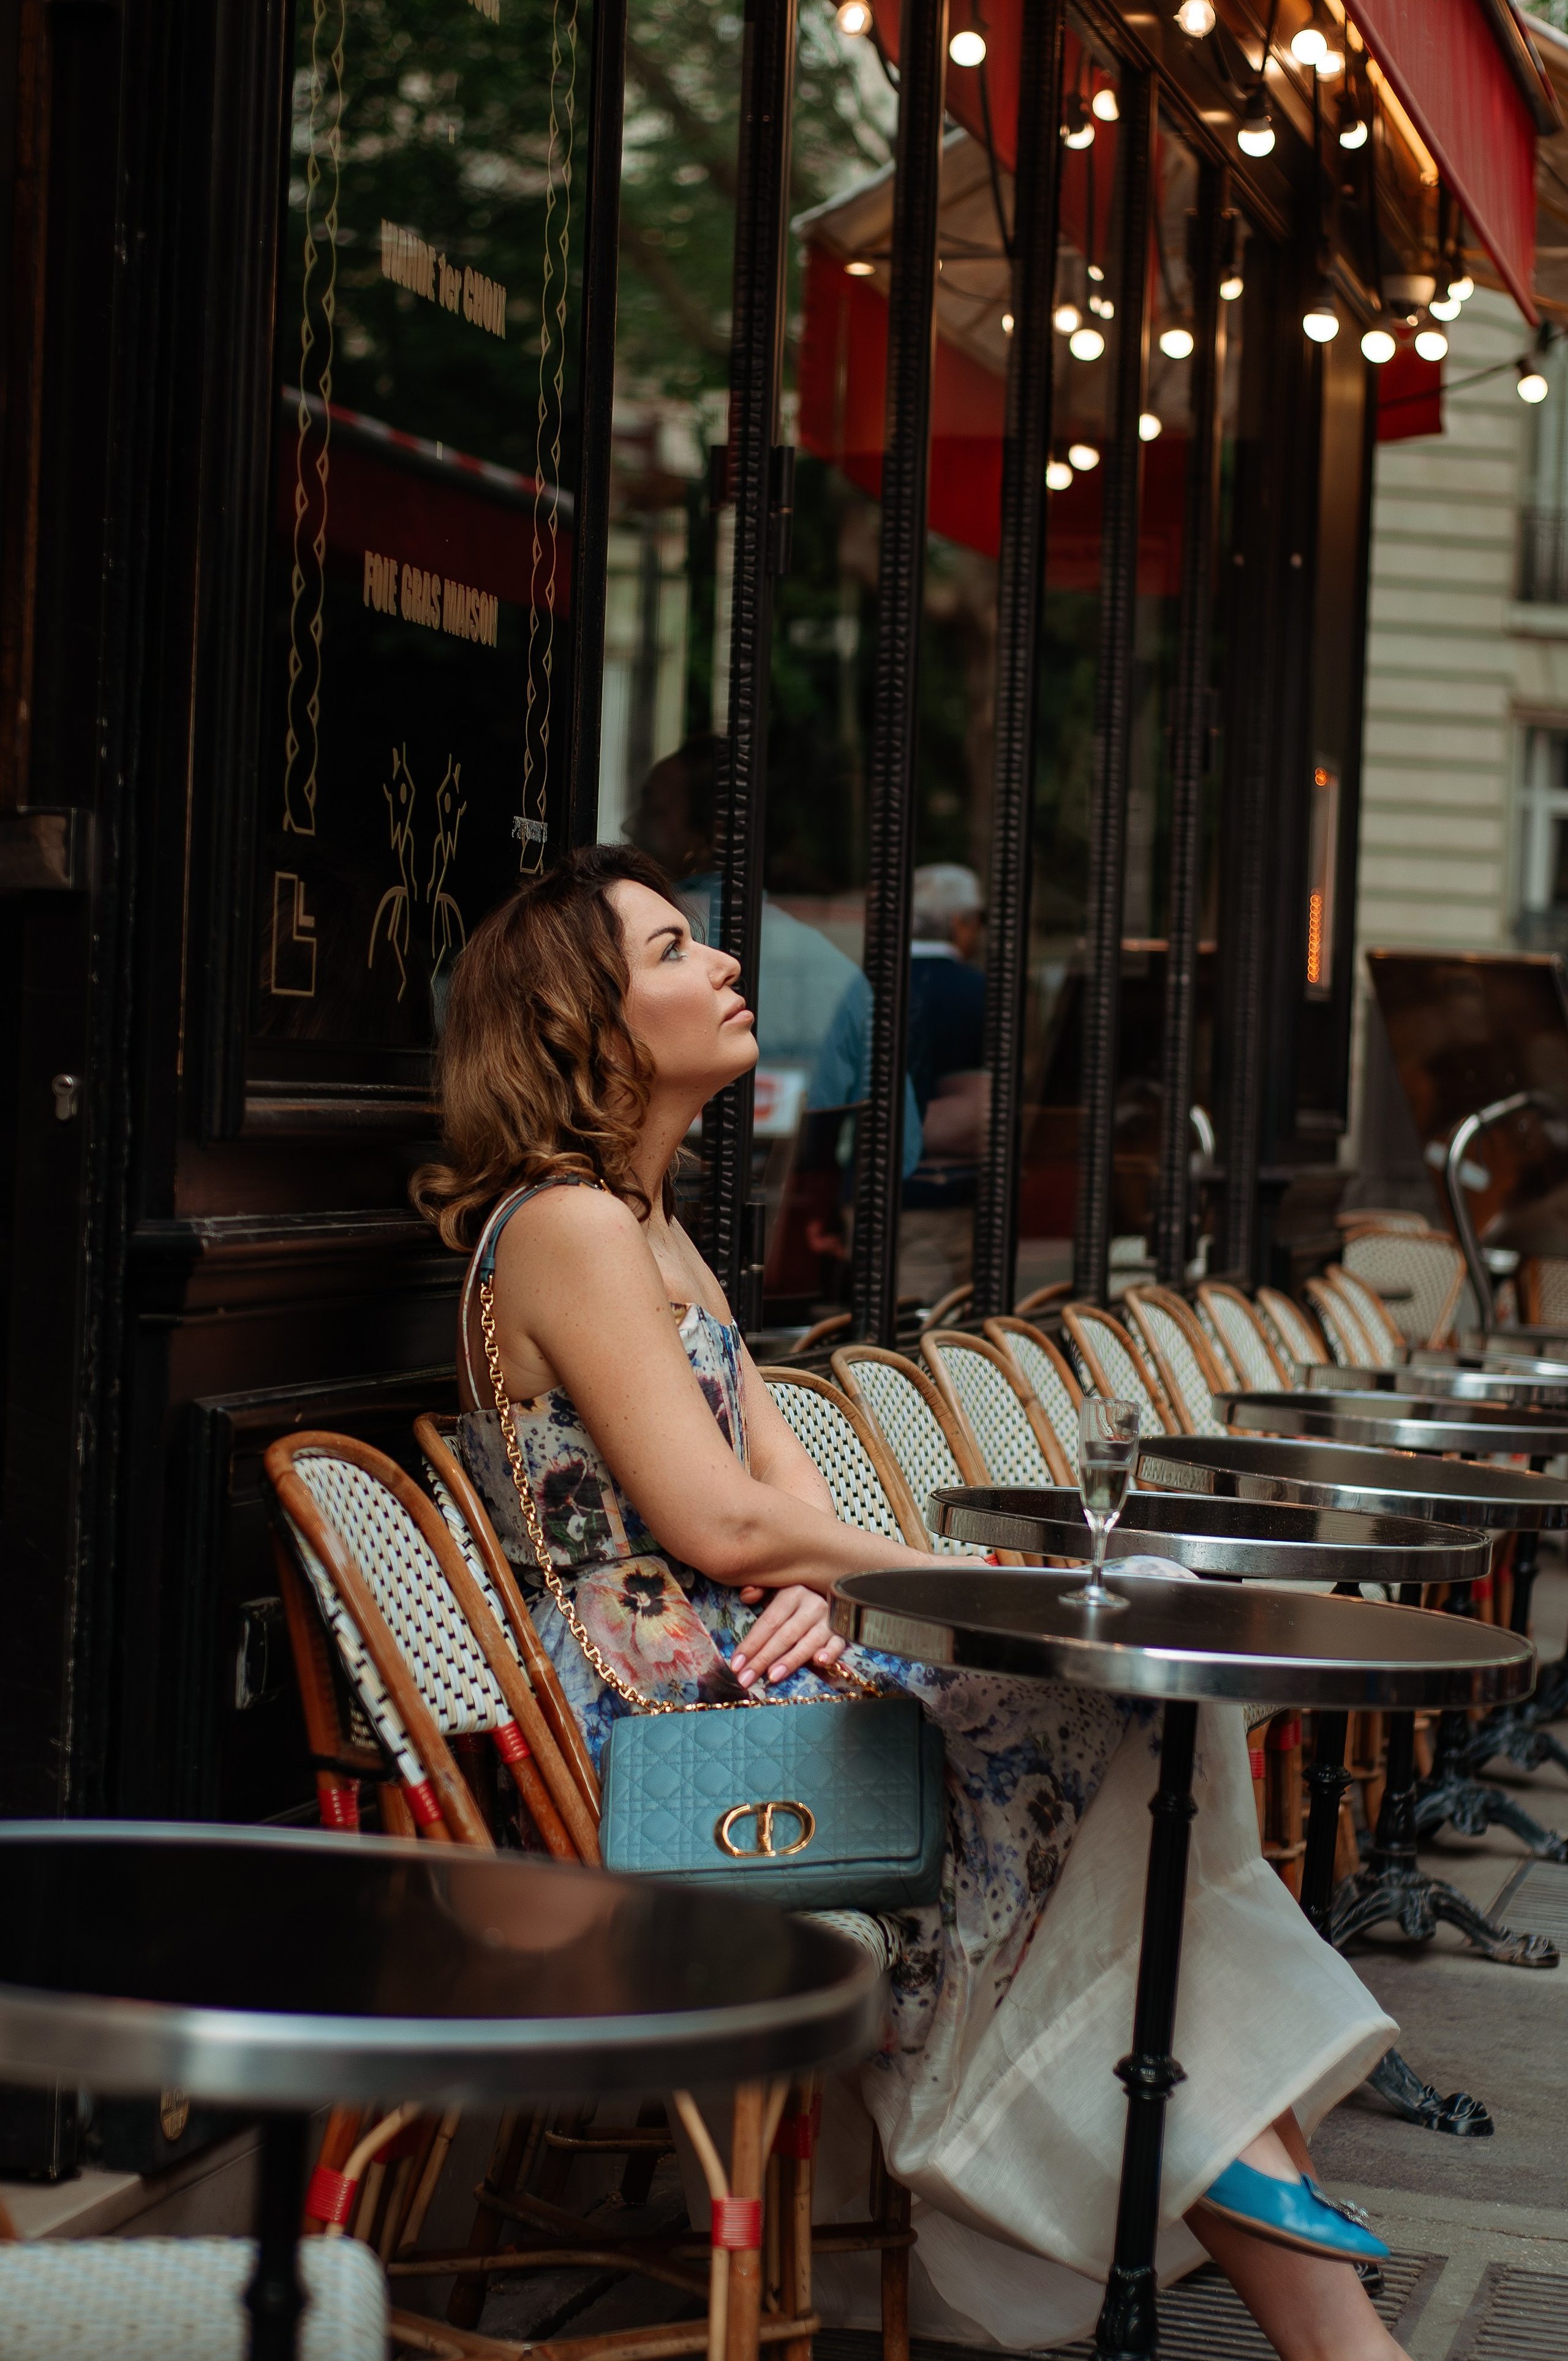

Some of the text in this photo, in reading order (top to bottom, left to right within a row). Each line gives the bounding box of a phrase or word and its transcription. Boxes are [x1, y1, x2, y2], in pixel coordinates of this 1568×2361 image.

[438, 252, 462, 315] 1er
[464, 266, 507, 341] CHOIX
[364, 550, 499, 648] FOIE GRAS MAISON
